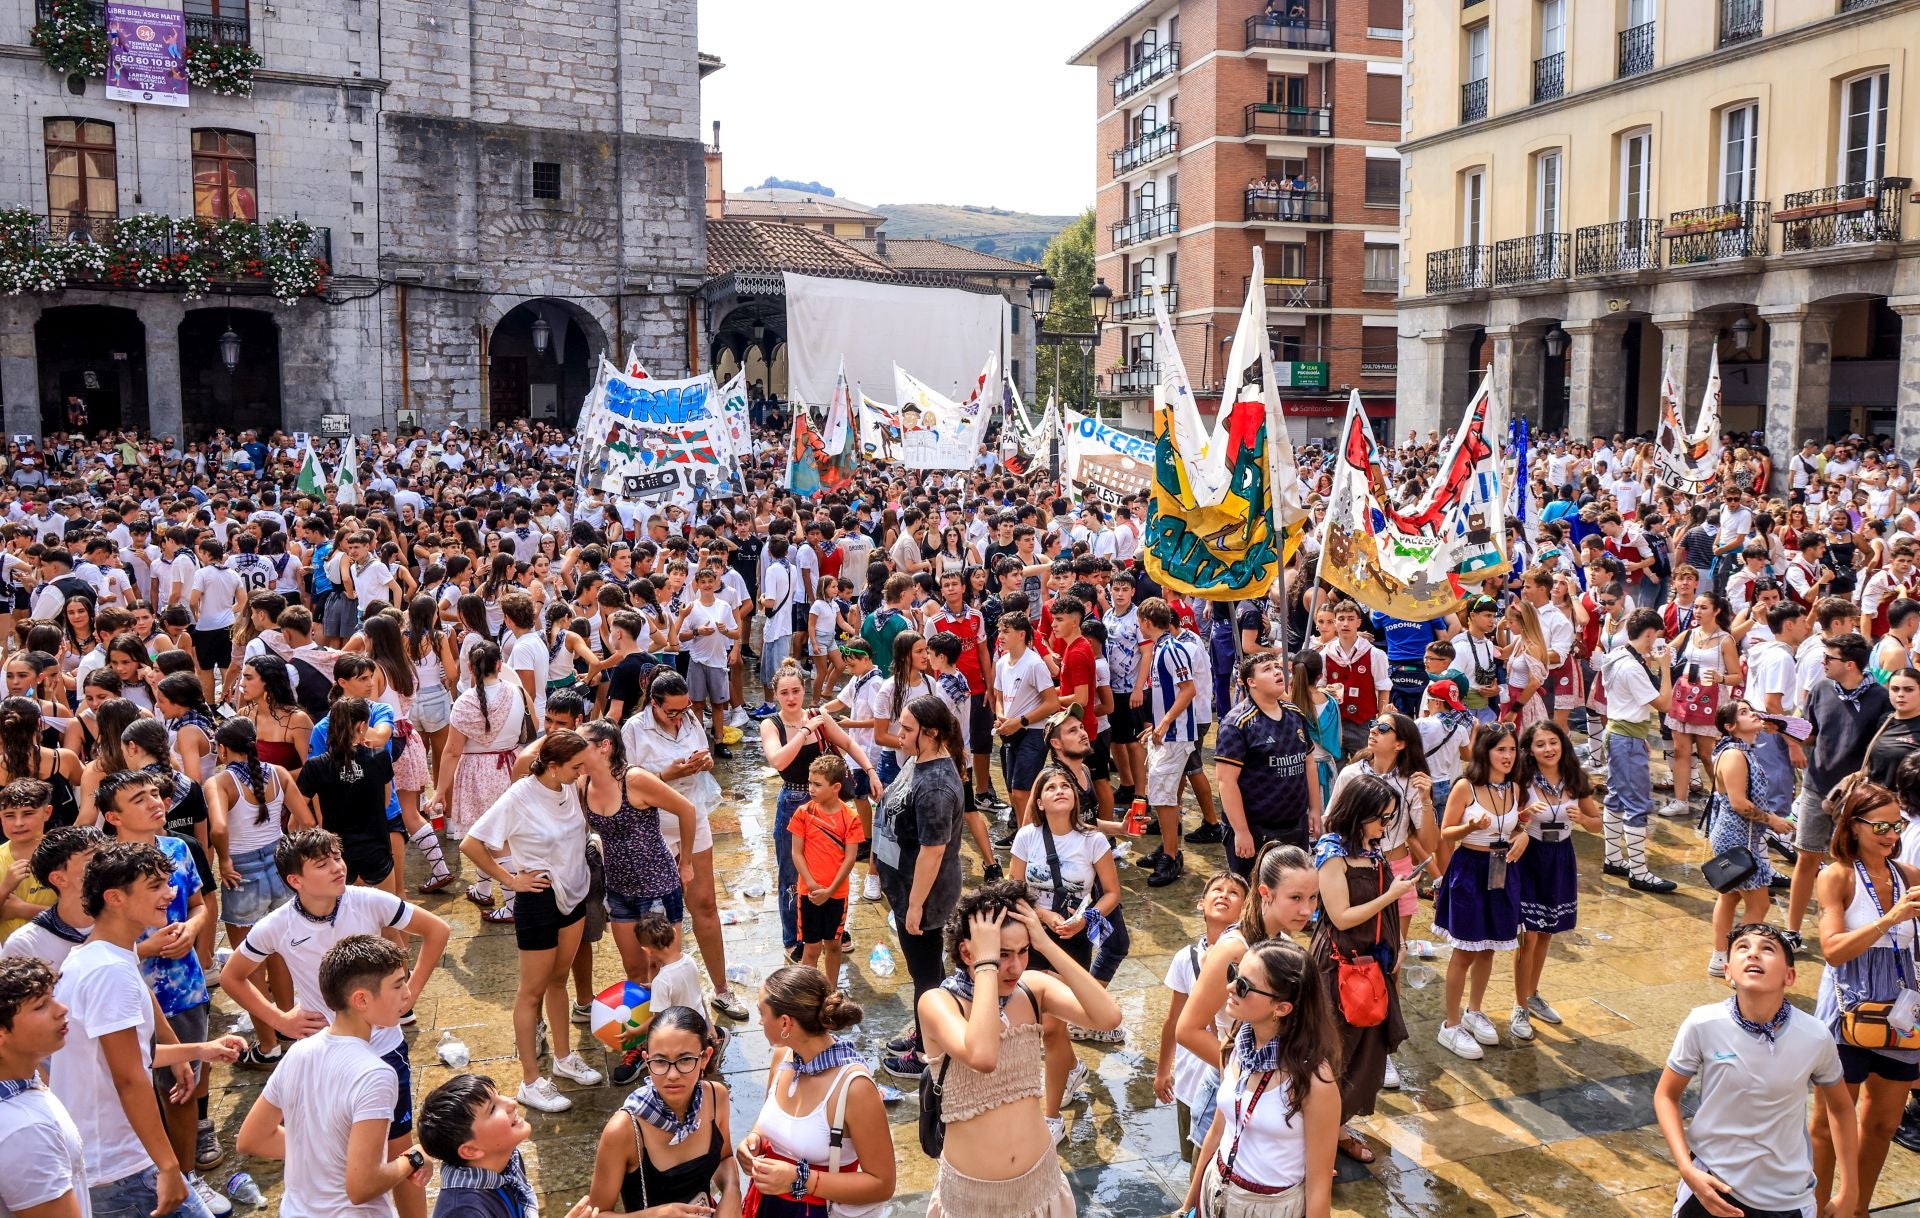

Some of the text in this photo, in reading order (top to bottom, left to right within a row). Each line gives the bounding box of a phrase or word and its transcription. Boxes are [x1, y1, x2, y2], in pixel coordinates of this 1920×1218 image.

[127, 9, 142, 18] BIZI,
[143, 11, 160, 19] ASKE
[160, 13, 181, 21] MAITE
[114, 54, 134, 63] 650
[135, 57, 149, 65] 80
[151, 58, 163, 67] 10
[164, 60, 178, 68] 80
[139, 82, 155, 90] 112
[1299, 405, 1335, 413] Santander
[240, 571, 266, 593] 18
